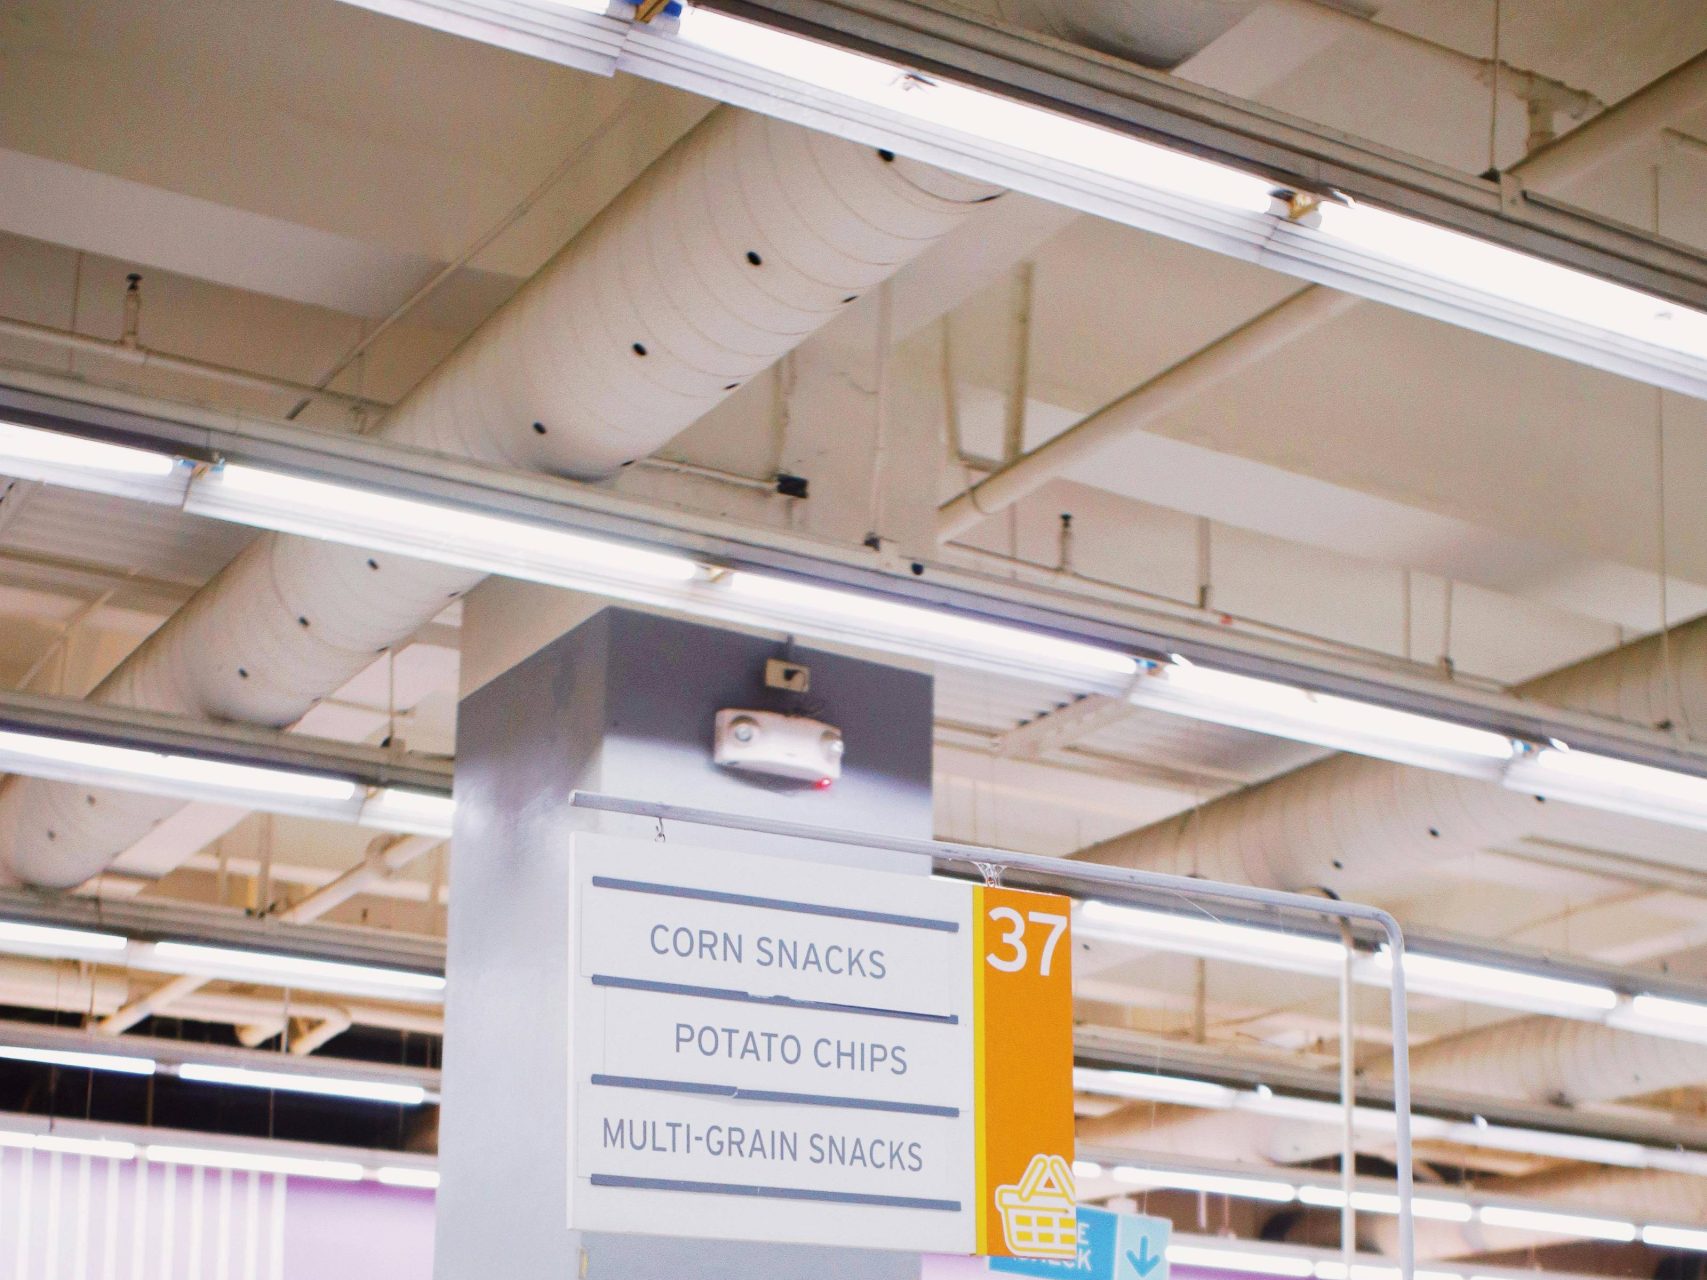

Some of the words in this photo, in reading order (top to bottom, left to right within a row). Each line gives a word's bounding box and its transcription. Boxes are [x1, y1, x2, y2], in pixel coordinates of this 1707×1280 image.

[650, 924, 743, 963] CORN
[756, 936, 887, 980] SNACKS
[985, 907, 1068, 976] 37
[675, 1023, 802, 1066] POTATO
[812, 1038, 908, 1075] CHIPS
[602, 1117, 798, 1162] MULTI-GRAIN
[809, 1133, 923, 1172] SNACKS
